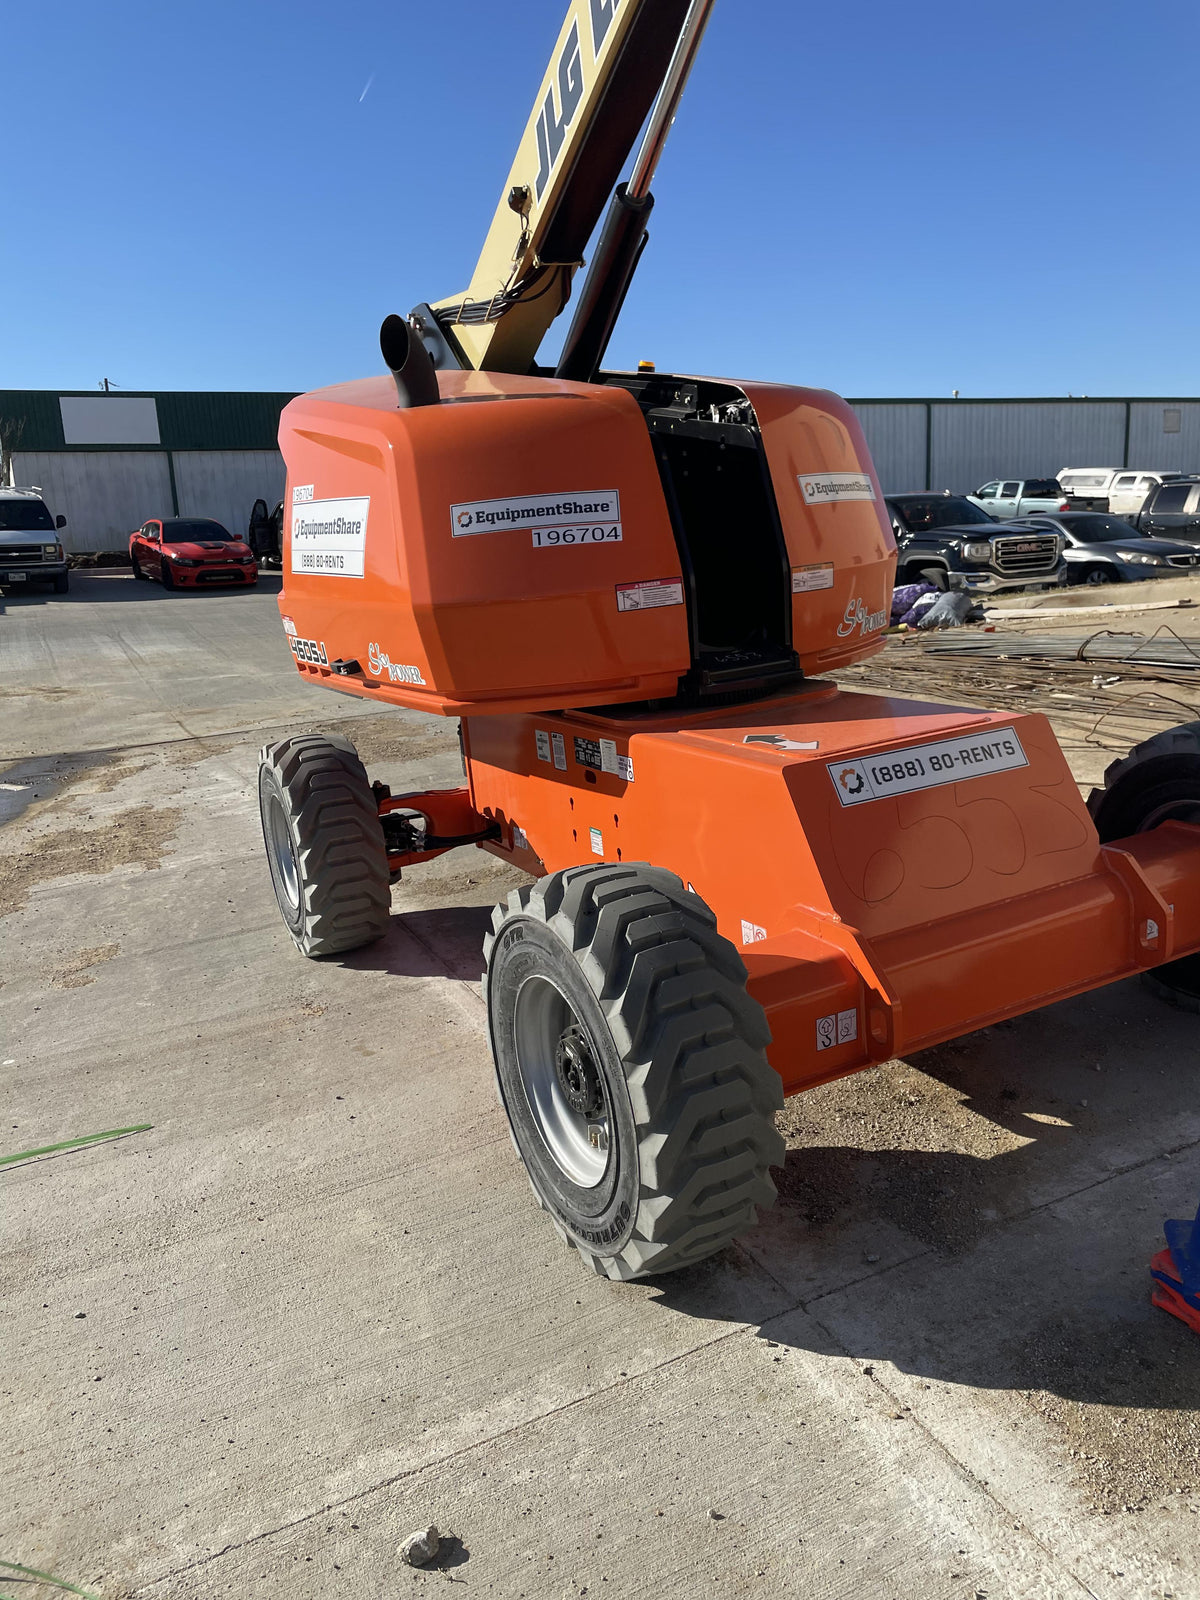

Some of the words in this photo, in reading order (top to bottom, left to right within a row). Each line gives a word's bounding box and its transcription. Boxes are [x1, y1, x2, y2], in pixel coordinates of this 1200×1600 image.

[535, 12, 584, 208] JLG
[293, 487, 313, 500] 196704
[815, 480, 872, 496] EquipmentShare
[475, 501, 610, 524] EquipmentShare
[300, 517, 361, 539] EquipmentShare
[533, 526, 620, 545] 196704
[1017, 542, 1042, 553] GMC
[301, 554, 315, 568] (888)
[316, 555, 344, 569] 80-RENTS
[289, 637, 328, 666] 460SJ
[389, 662, 426, 685] POWER
[872, 758, 925, 785] (888)
[931, 740, 1016, 771] 80-RENTS
